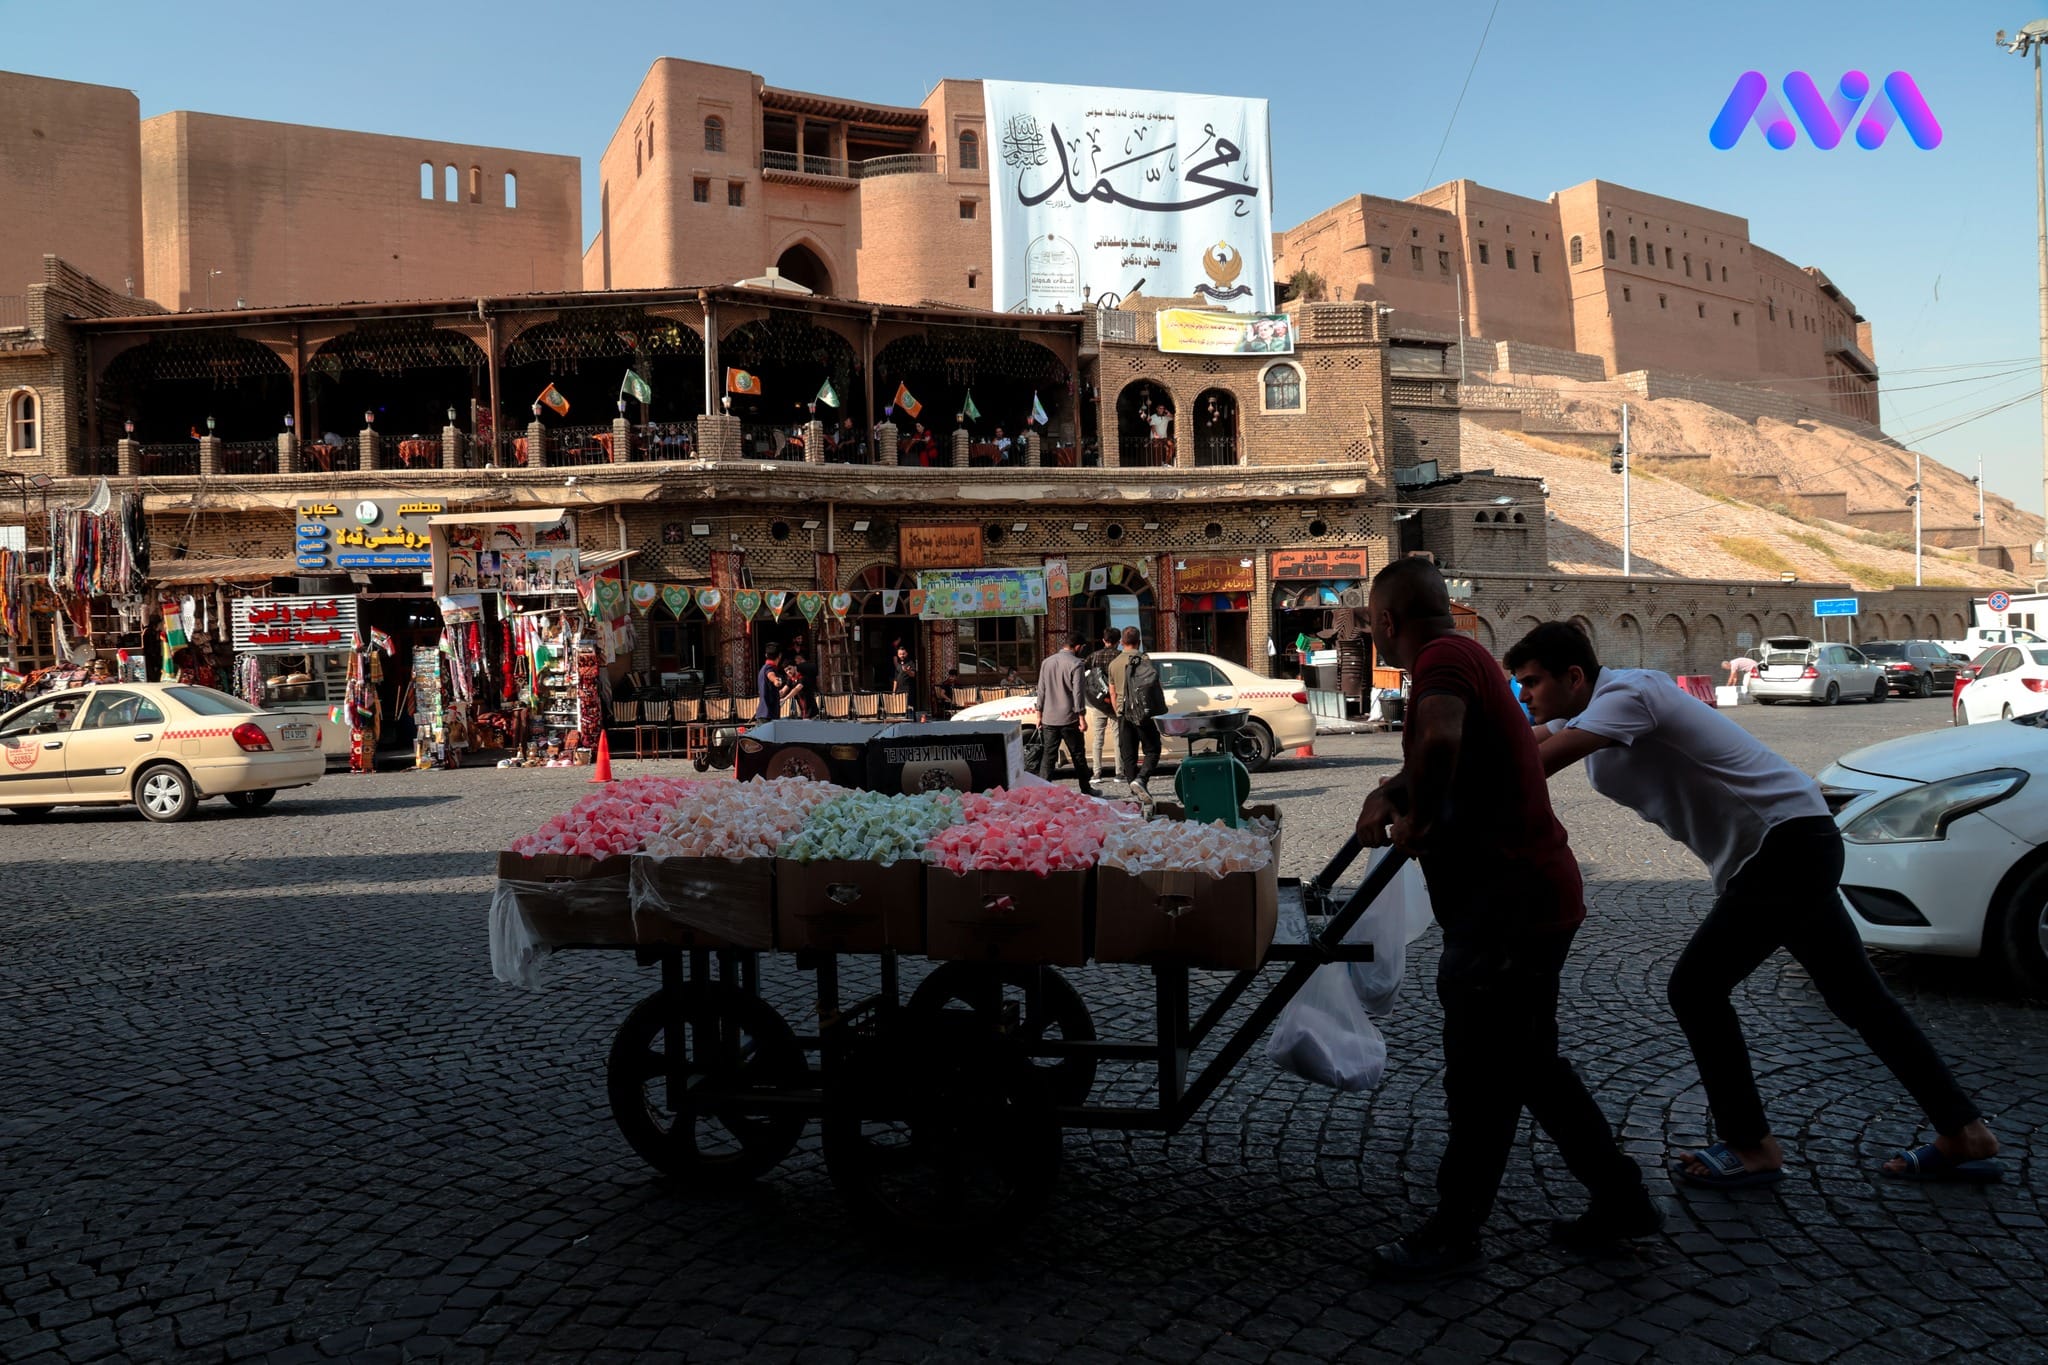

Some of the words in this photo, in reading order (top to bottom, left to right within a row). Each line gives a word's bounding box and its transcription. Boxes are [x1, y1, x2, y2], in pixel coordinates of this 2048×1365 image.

[397, 502, 442, 516] مطعم
[883, 747, 930, 764] KERNEL
[933, 744, 987, 762] WALNUT
